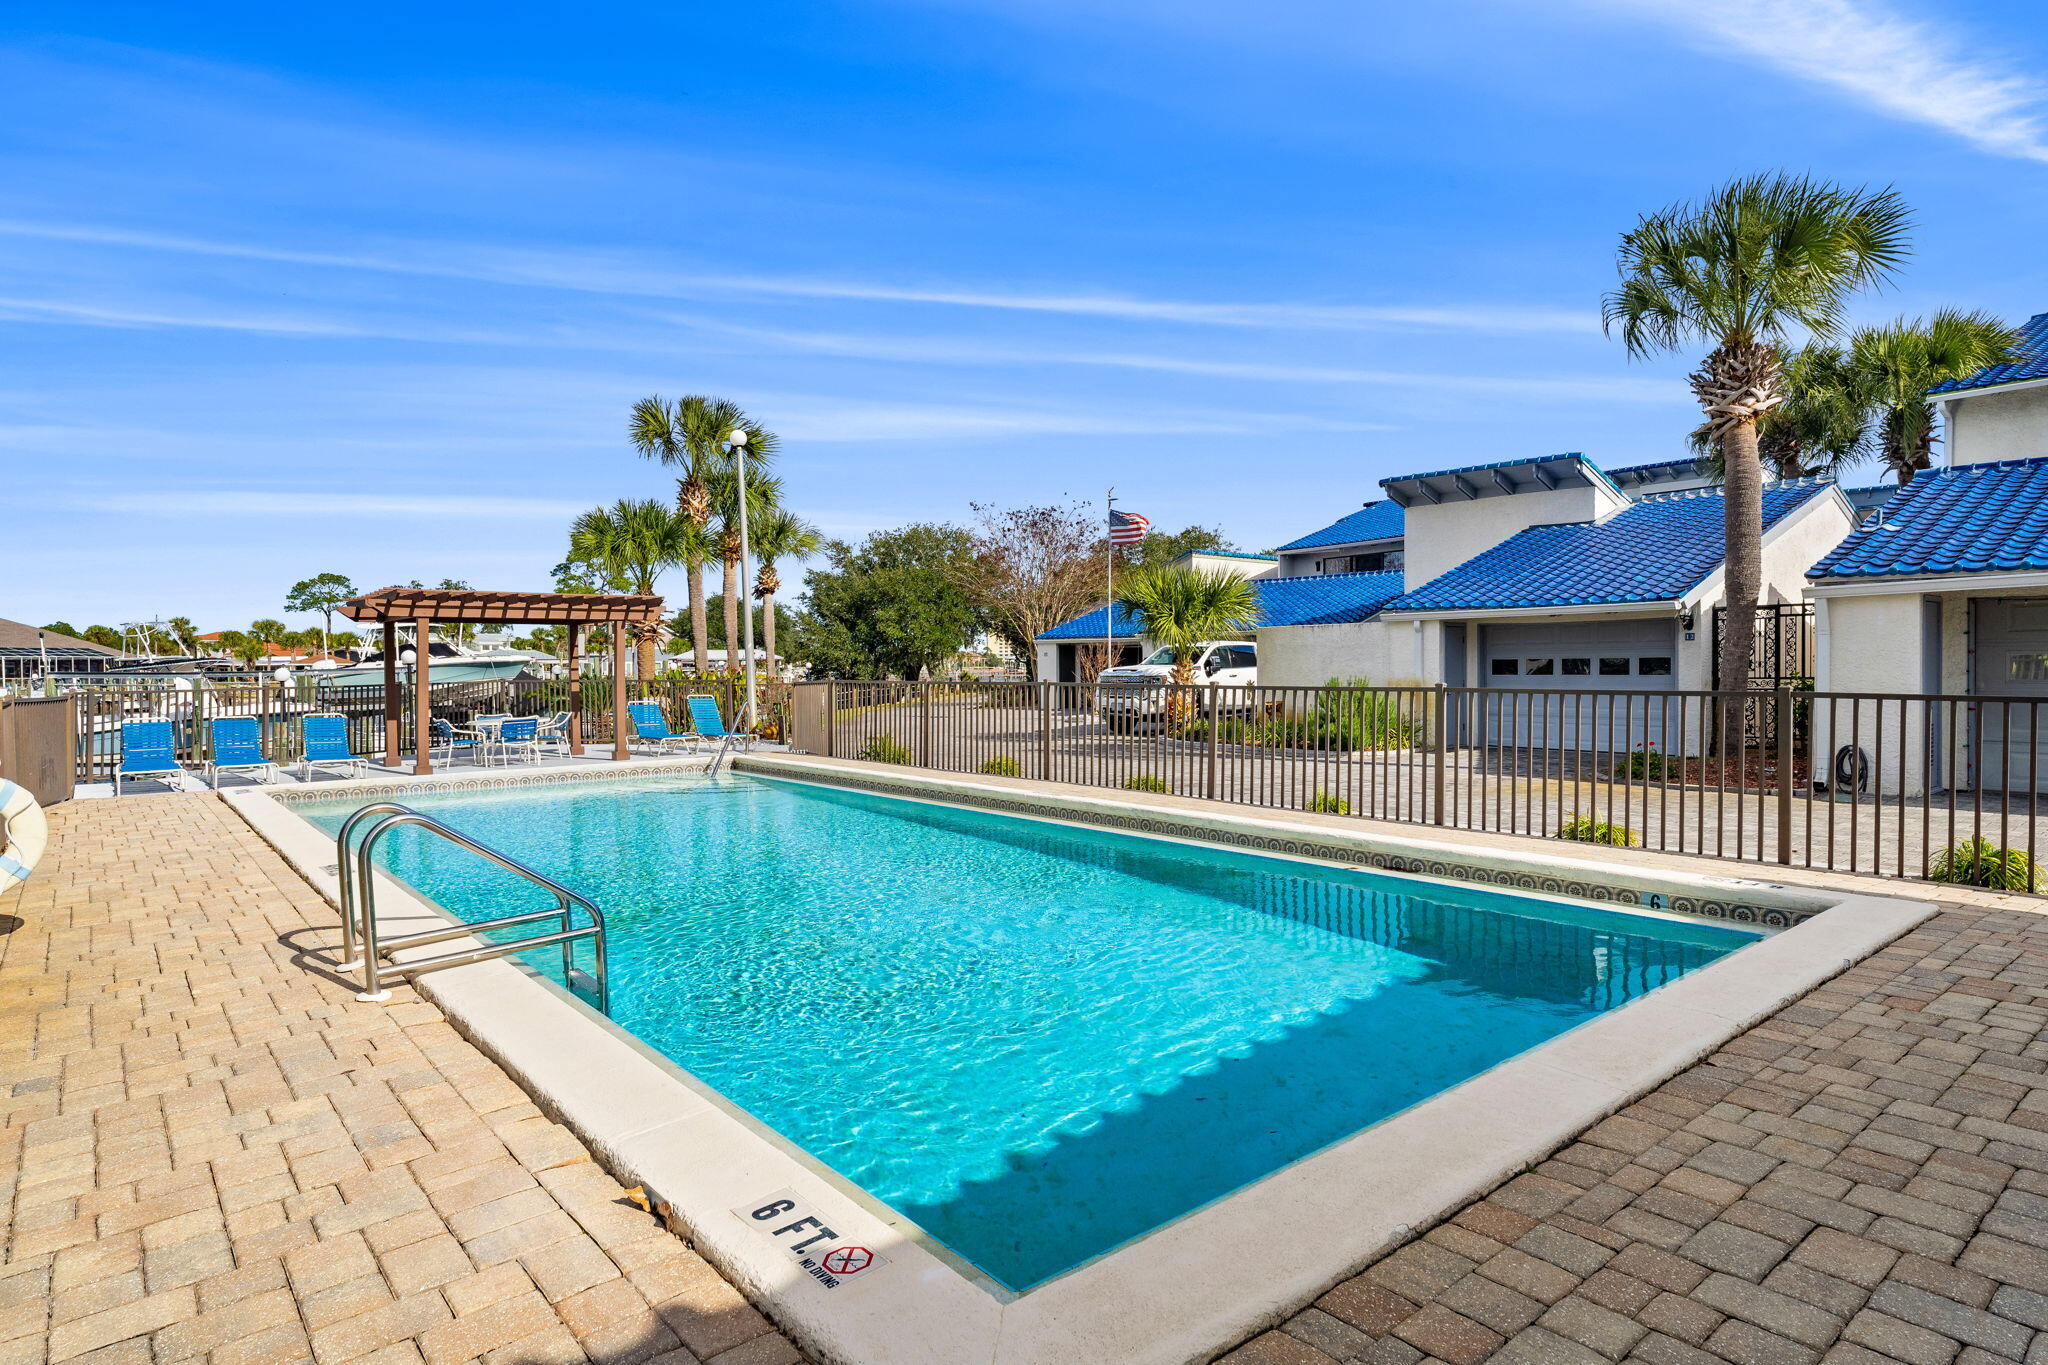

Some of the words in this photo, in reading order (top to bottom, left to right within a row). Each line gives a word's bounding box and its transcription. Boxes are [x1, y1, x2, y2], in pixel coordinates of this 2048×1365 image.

[1650, 894, 1661, 909] 6
[751, 1199, 796, 1221] 6
[771, 1215, 840, 1255] FT.
[798, 1257, 817, 1269] NO
[808, 1266, 840, 1289] DIVING
